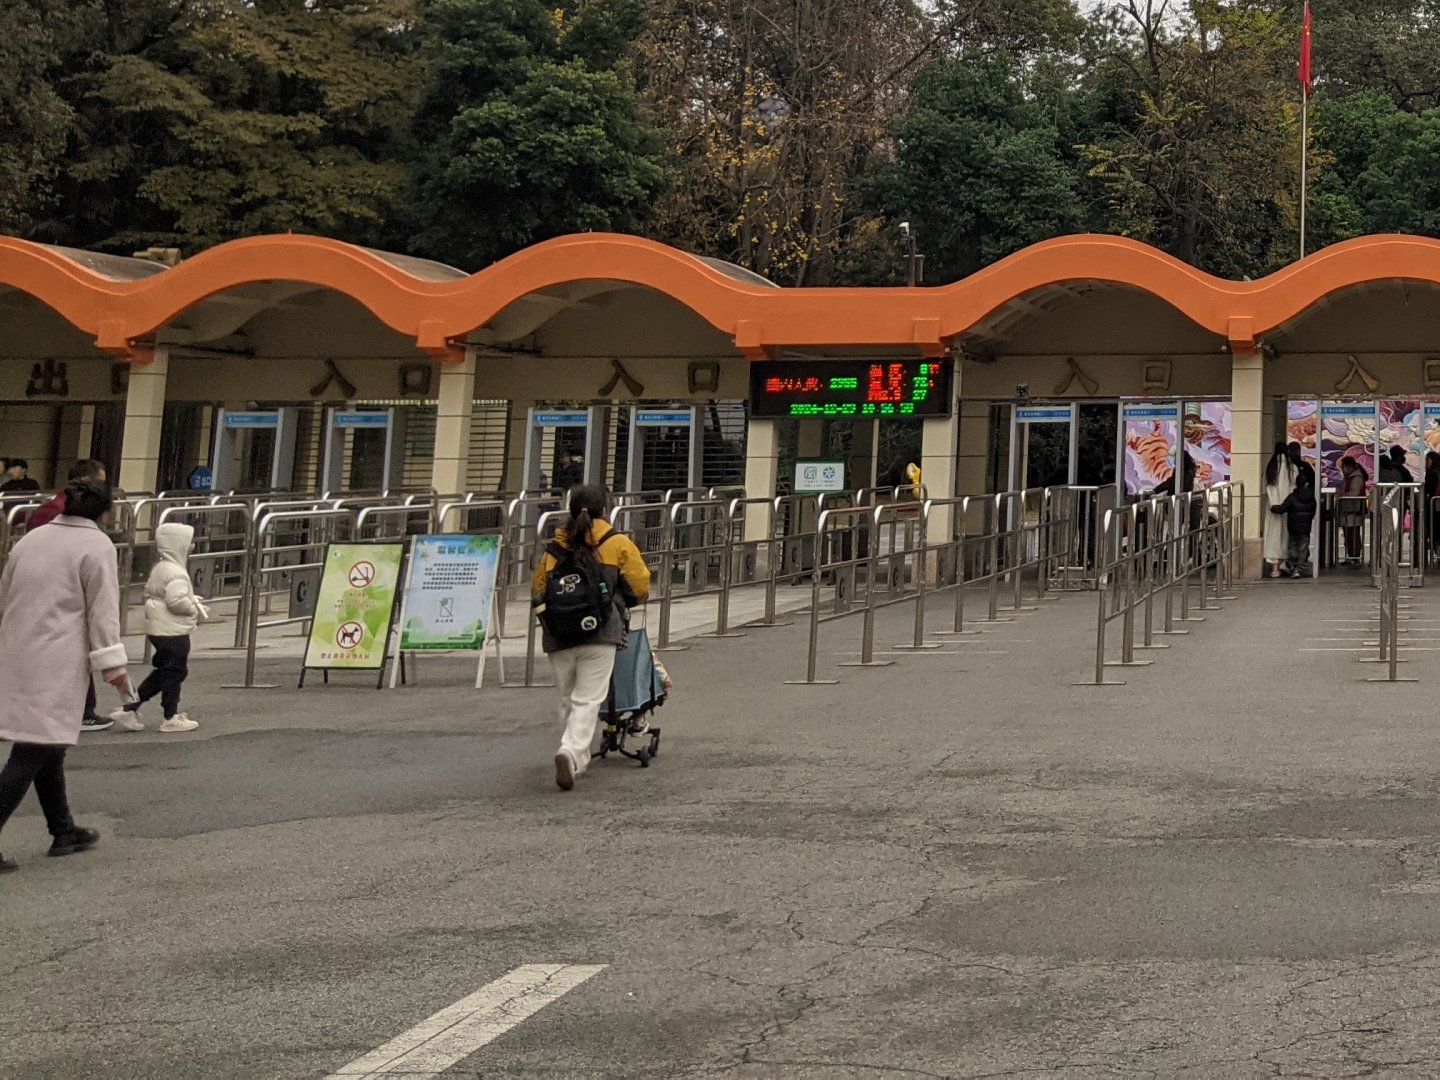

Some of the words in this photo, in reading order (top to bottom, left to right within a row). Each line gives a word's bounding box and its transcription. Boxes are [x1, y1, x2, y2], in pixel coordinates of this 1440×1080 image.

[25, 358, 130, 397] 出口
[310, 357, 432, 400] 入口
[597, 358, 720, 397] 入口
[1053, 356, 1173, 396] 入口
